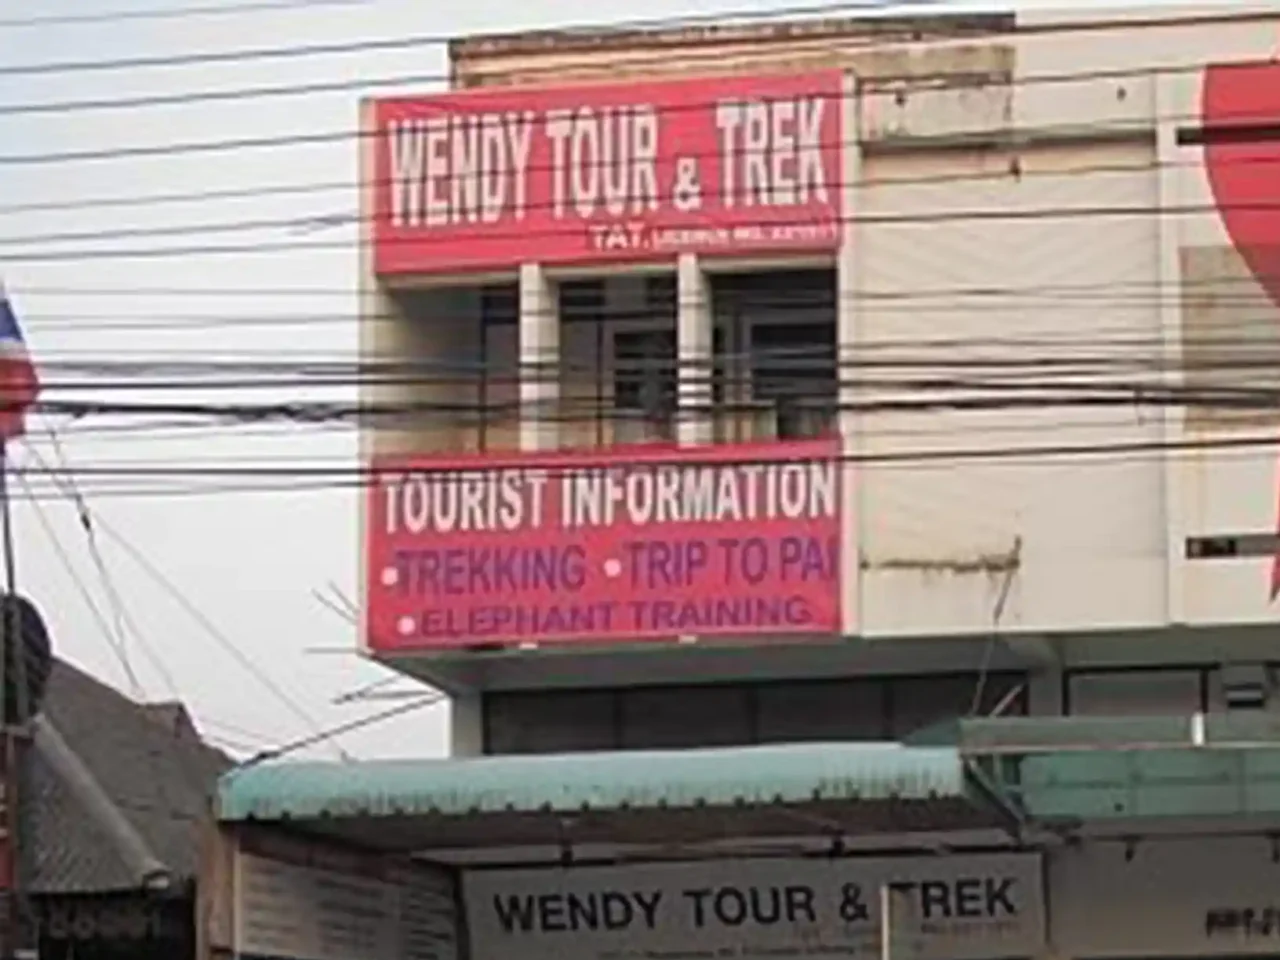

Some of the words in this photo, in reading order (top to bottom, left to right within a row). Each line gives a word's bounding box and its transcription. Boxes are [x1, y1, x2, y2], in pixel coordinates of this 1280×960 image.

[388, 111, 534, 227] WENDY
[547, 103, 659, 220] TOUR
[673, 157, 703, 211] &
[717, 98, 829, 207] TREK
[381, 470, 547, 533] TOURIST
[561, 462, 835, 529] INFORMATION
[396, 546, 586, 597] TREKKING
[622, 540, 706, 590] TRIP
[717, 538, 769, 586] TO
[421, 604, 614, 637] ELEPHANT
[631, 598, 812, 631] TRAINING
[494, 888, 662, 933] WENDY
[683, 886, 816, 926] TOUR
[841, 884, 869, 922] &
